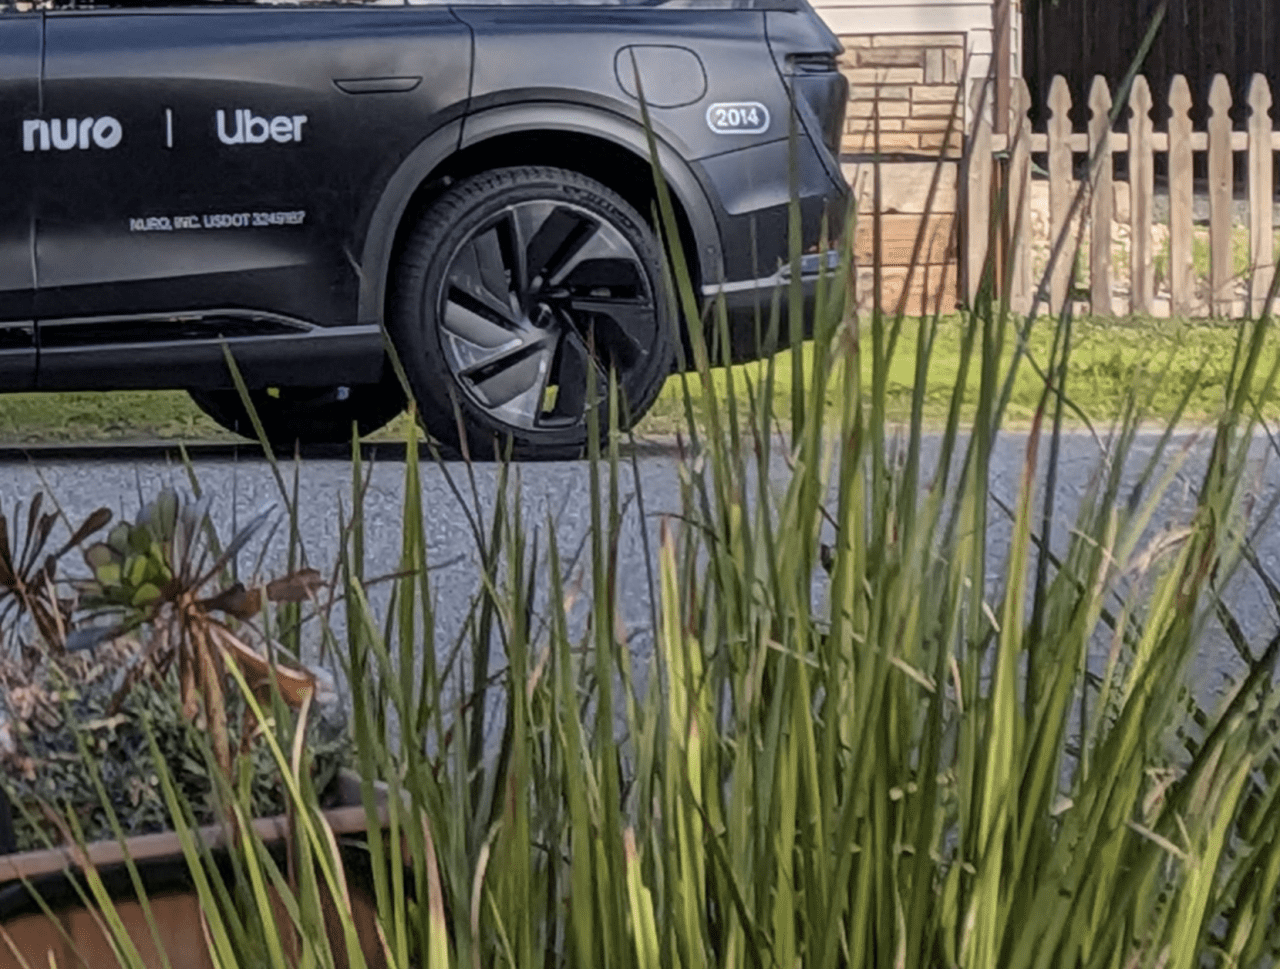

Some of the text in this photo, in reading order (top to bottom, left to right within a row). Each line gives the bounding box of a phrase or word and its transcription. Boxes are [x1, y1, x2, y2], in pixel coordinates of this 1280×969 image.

[715, 108, 759, 126] 2014
[23, 116, 123, 151] nuro
[217, 109, 308, 145] Uber
[203, 212, 250, 228] USDOT
